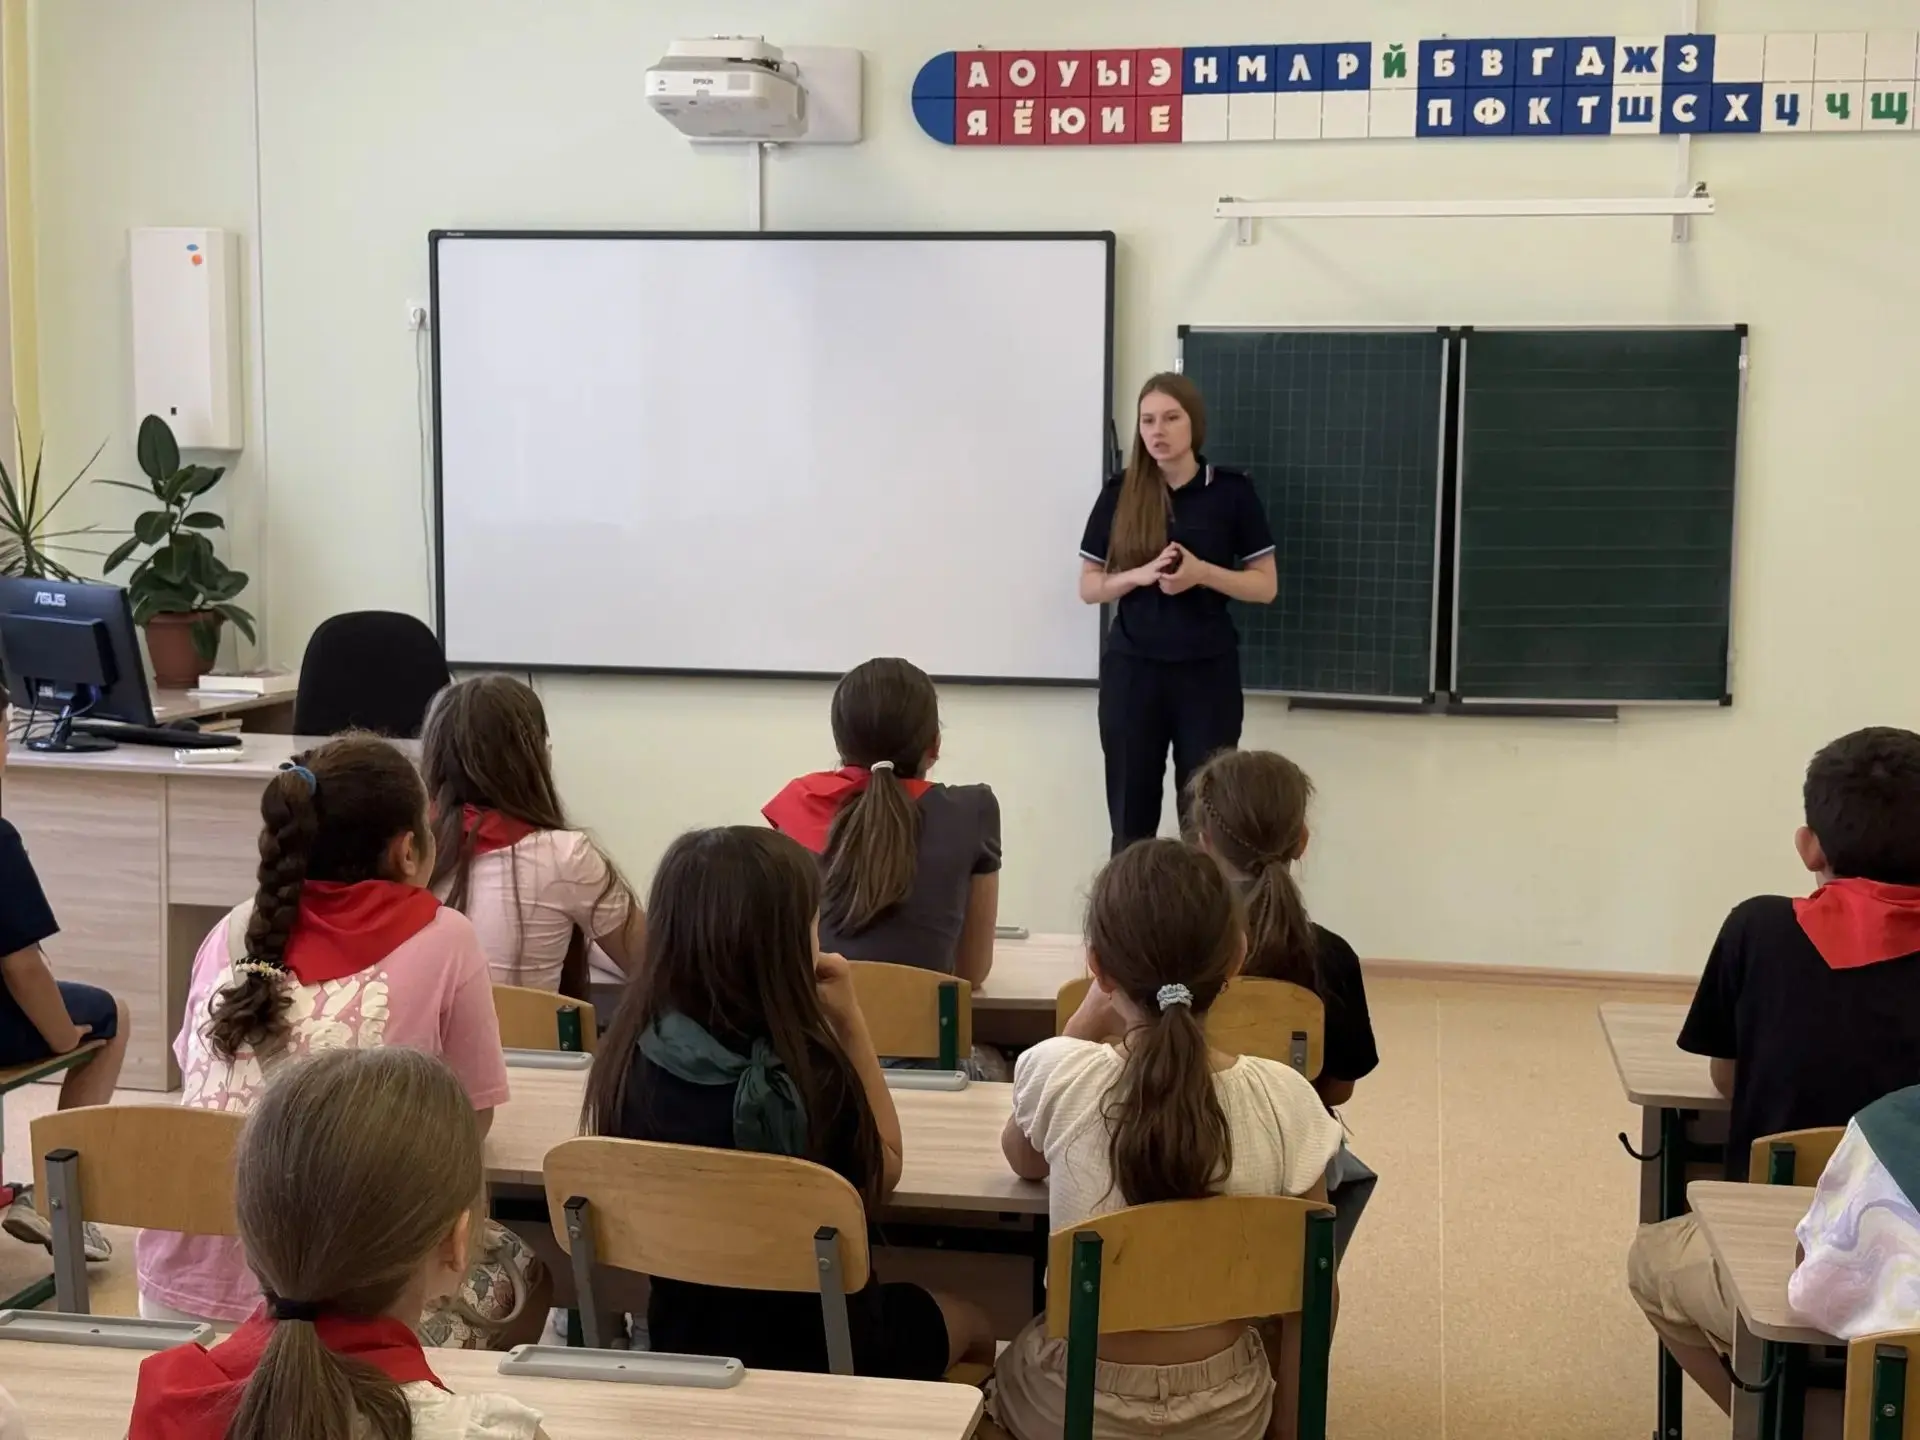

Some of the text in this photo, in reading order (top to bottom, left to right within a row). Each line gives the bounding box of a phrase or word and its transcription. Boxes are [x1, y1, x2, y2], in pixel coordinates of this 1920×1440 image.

[968, 44, 1699, 87] А О У Ы Э Н М Л Р Й Б В Г Д Ж З
[967, 92, 1909, 136] Я Ё Ю И Е П Ф К Т Ш С Х Ц Ч Щ
[34, 591, 66, 607] ASUS
